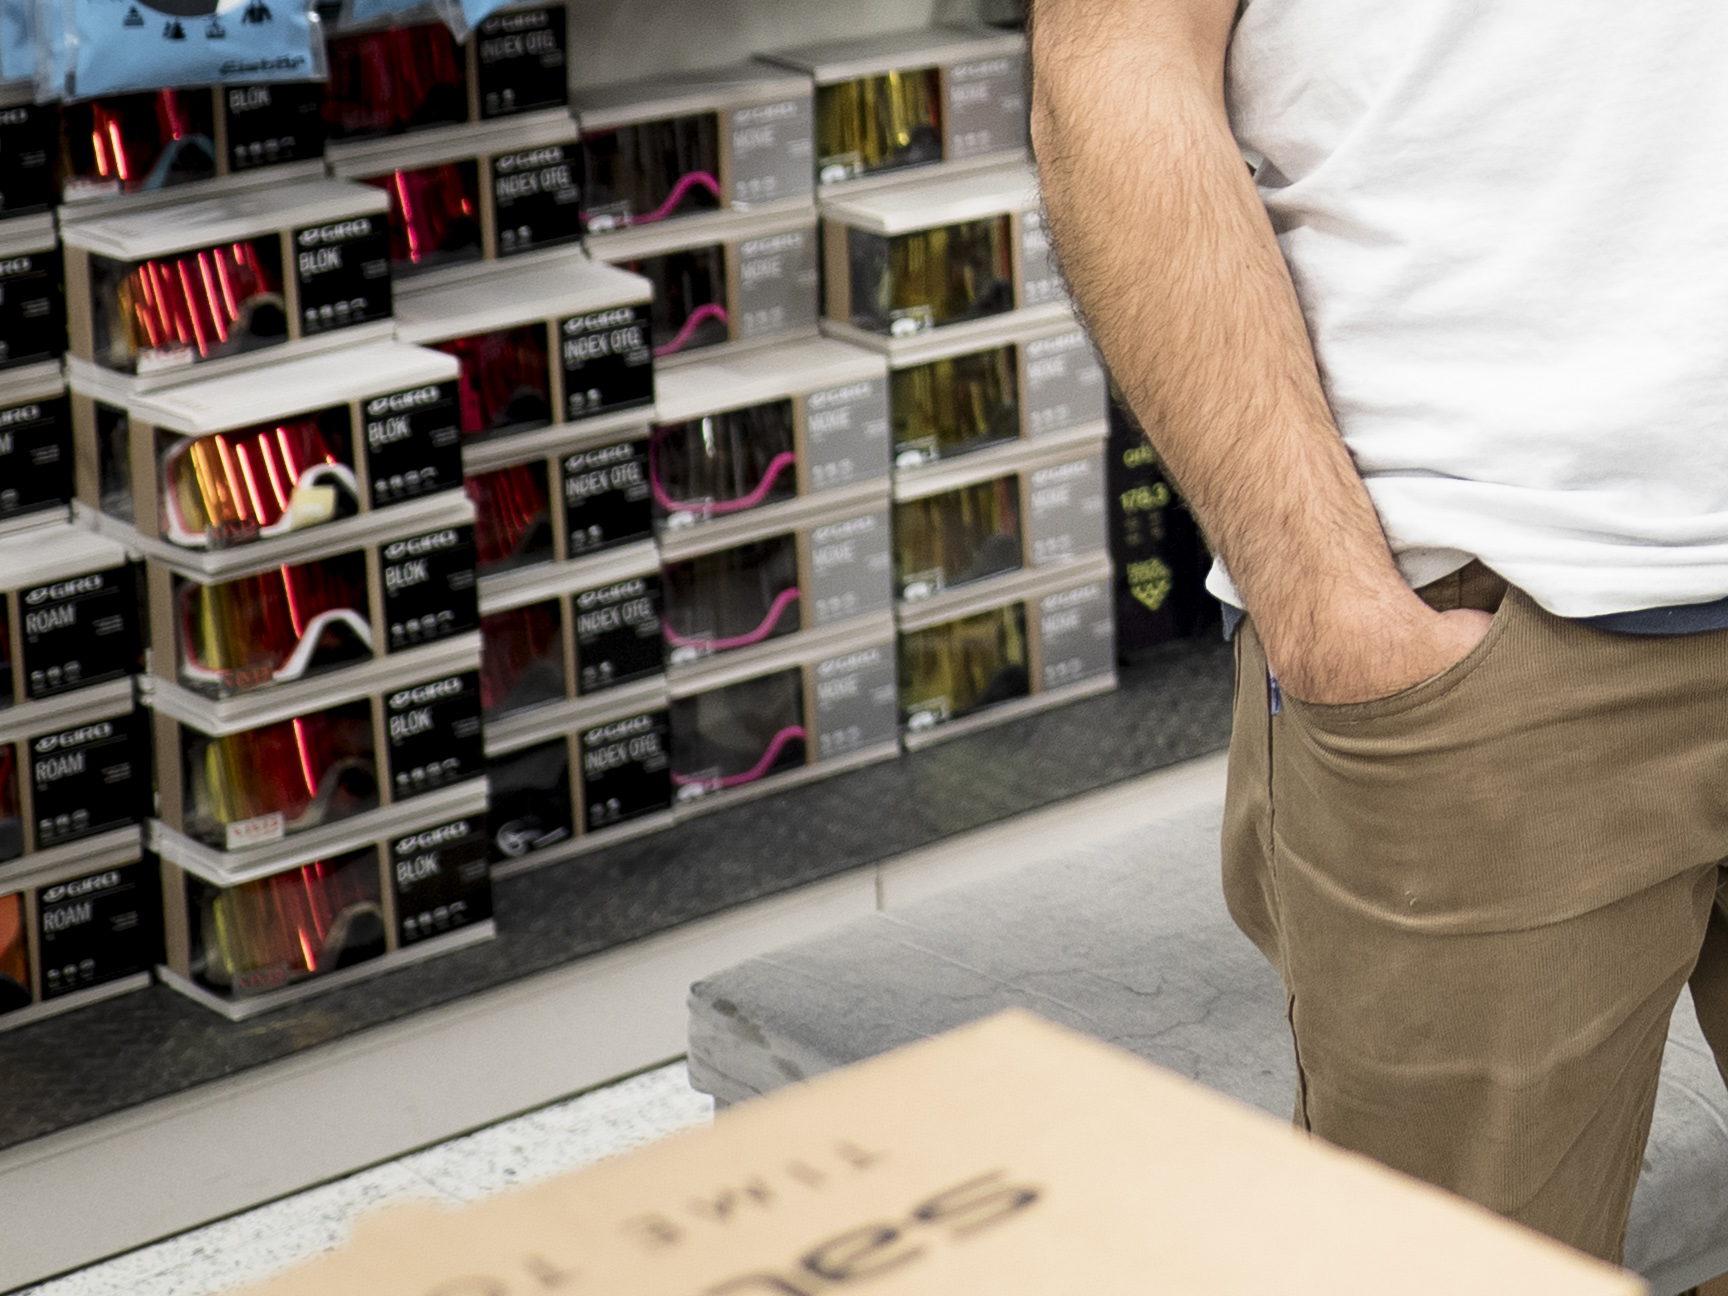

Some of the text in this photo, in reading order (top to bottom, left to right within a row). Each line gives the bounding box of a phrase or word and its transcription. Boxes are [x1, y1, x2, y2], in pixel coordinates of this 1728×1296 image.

[299, 246, 342, 275] BLOK
[368, 415, 412, 445] BLOK
[385, 559, 429, 589] BLOK
[25, 605, 75, 635] ROAM
[389, 707, 433, 737] BLOK
[35, 752, 85, 783] ROAM
[396, 852, 439, 884] BLOK
[43, 902, 94, 933] ROAM
